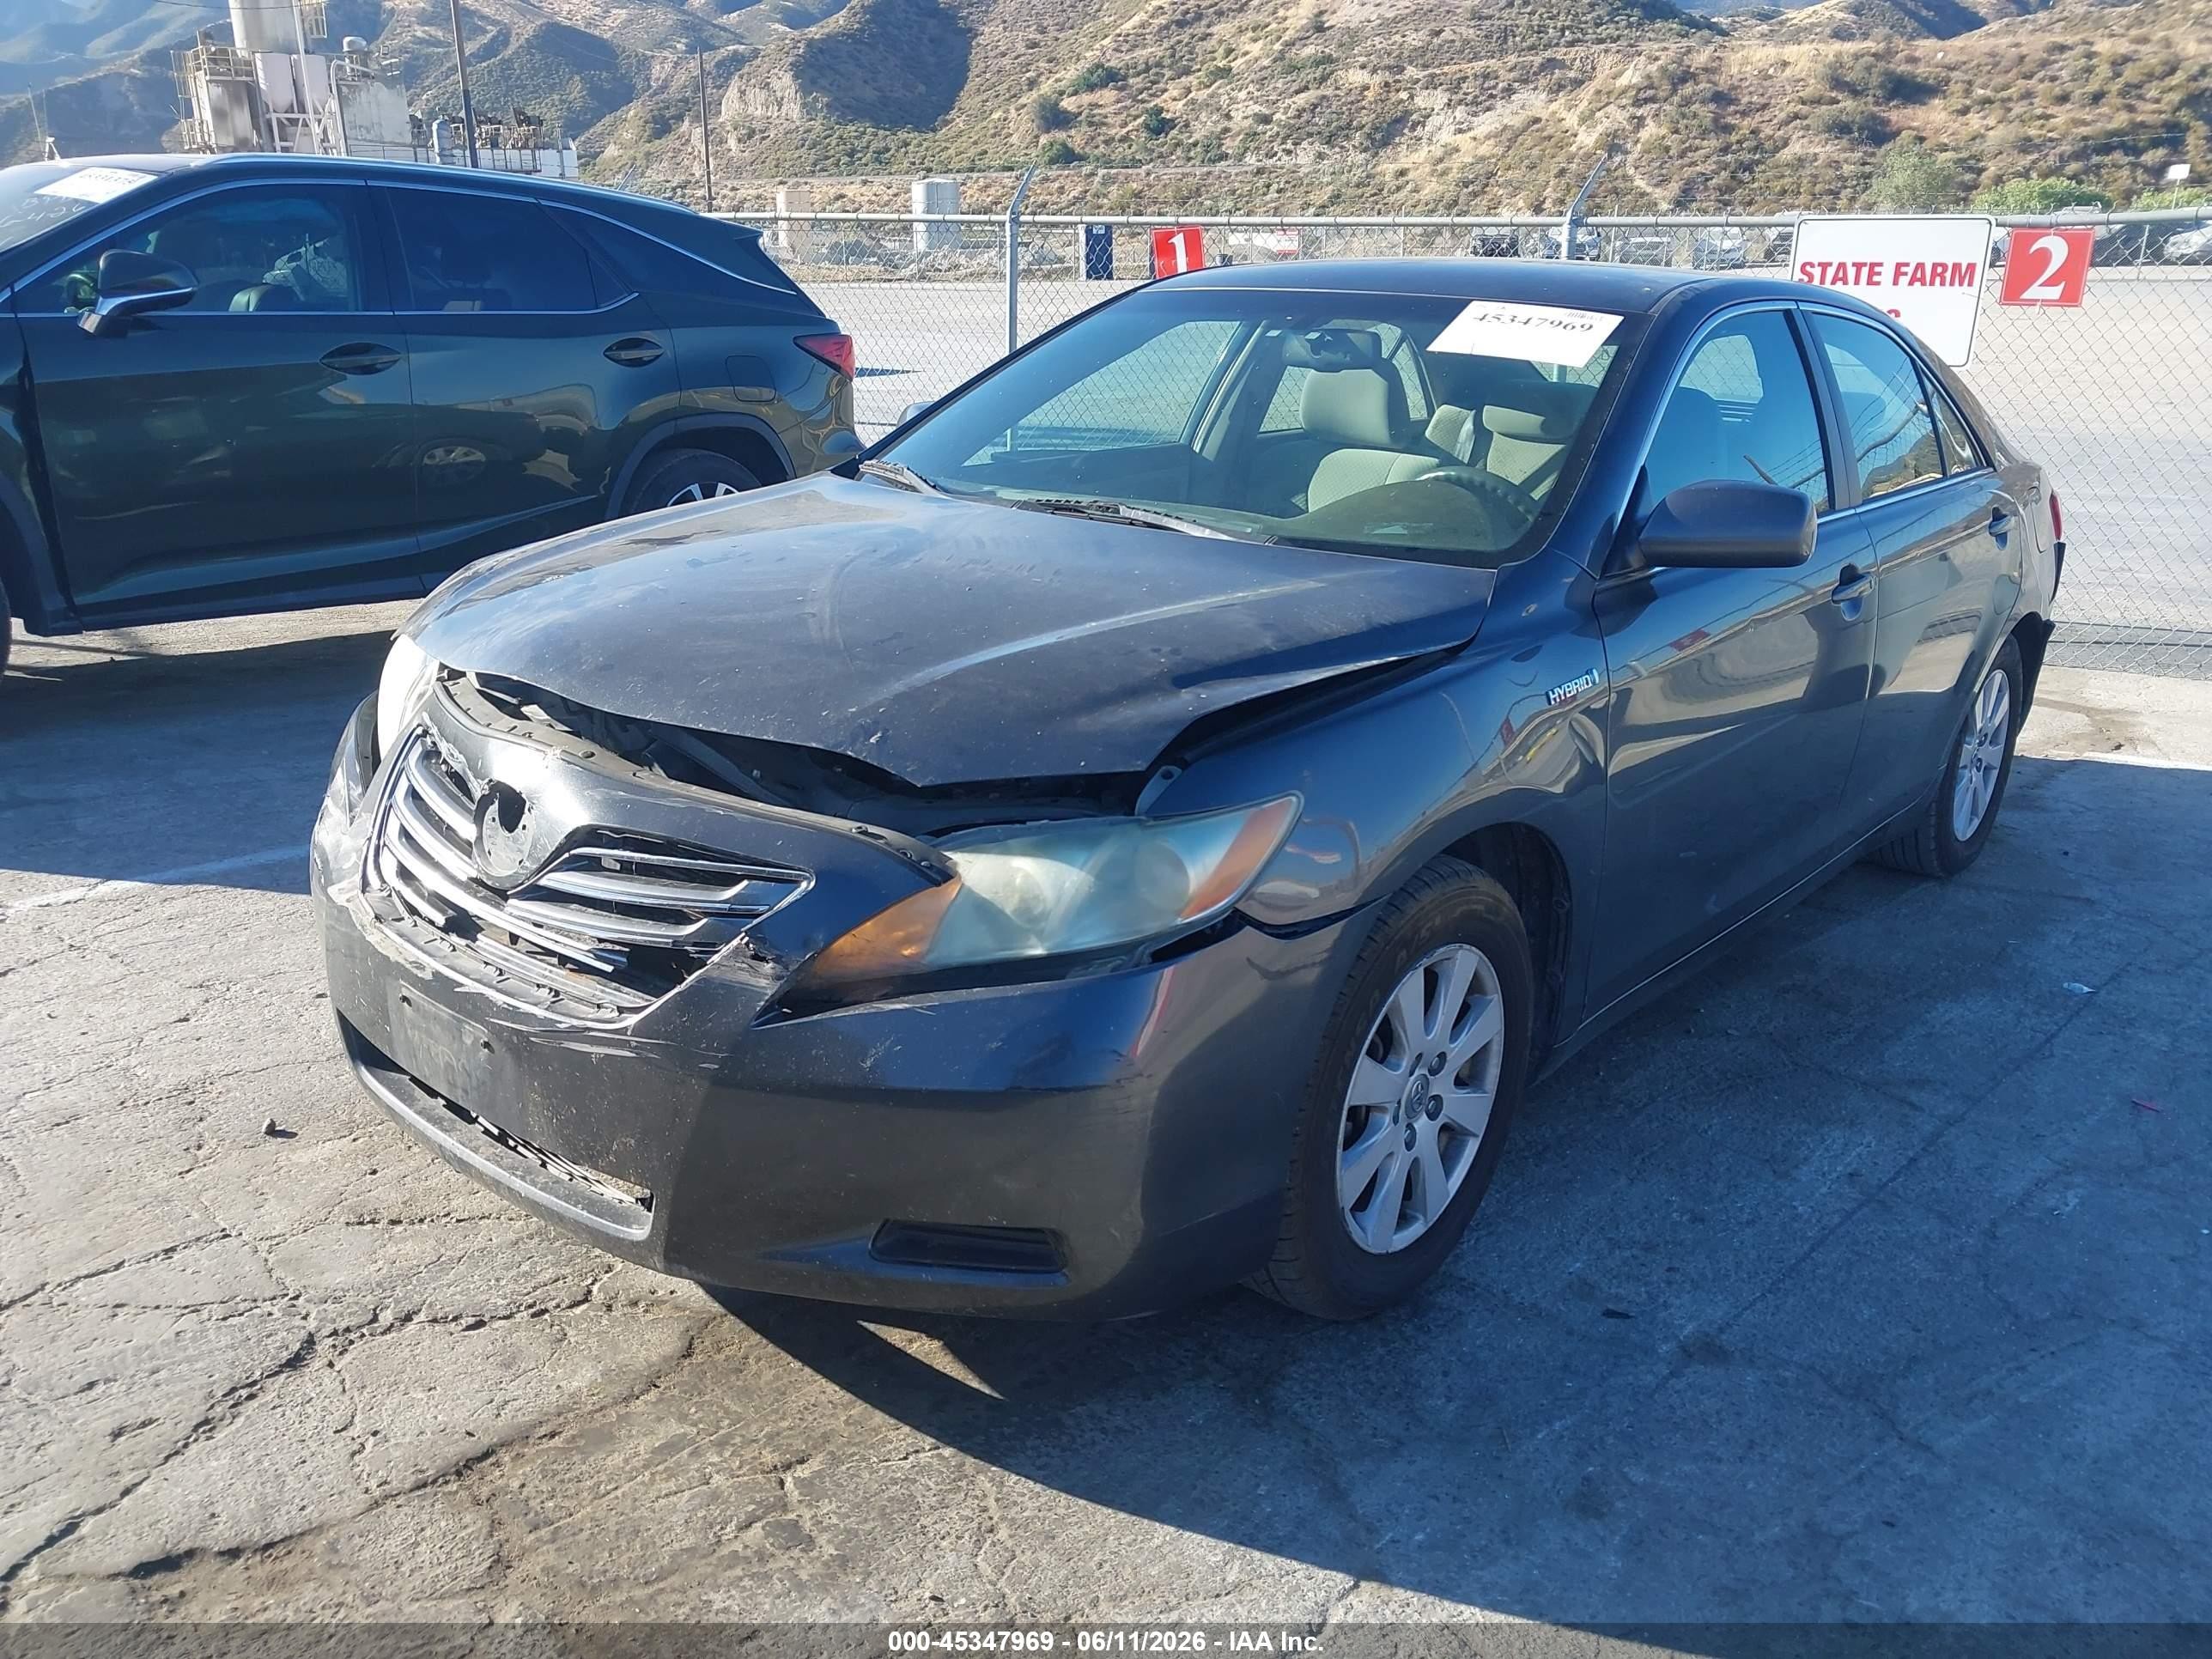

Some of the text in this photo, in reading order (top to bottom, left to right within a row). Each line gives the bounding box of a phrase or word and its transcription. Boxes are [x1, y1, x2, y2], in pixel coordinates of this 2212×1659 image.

[1168, 232, 1187, 274] 1
[2020, 235, 2069, 300] 2
[1798, 261, 1977, 287] STATE FARM
[1473, 313, 1594, 332] 45347969
[1548, 674, 1593, 705] HYBRID
